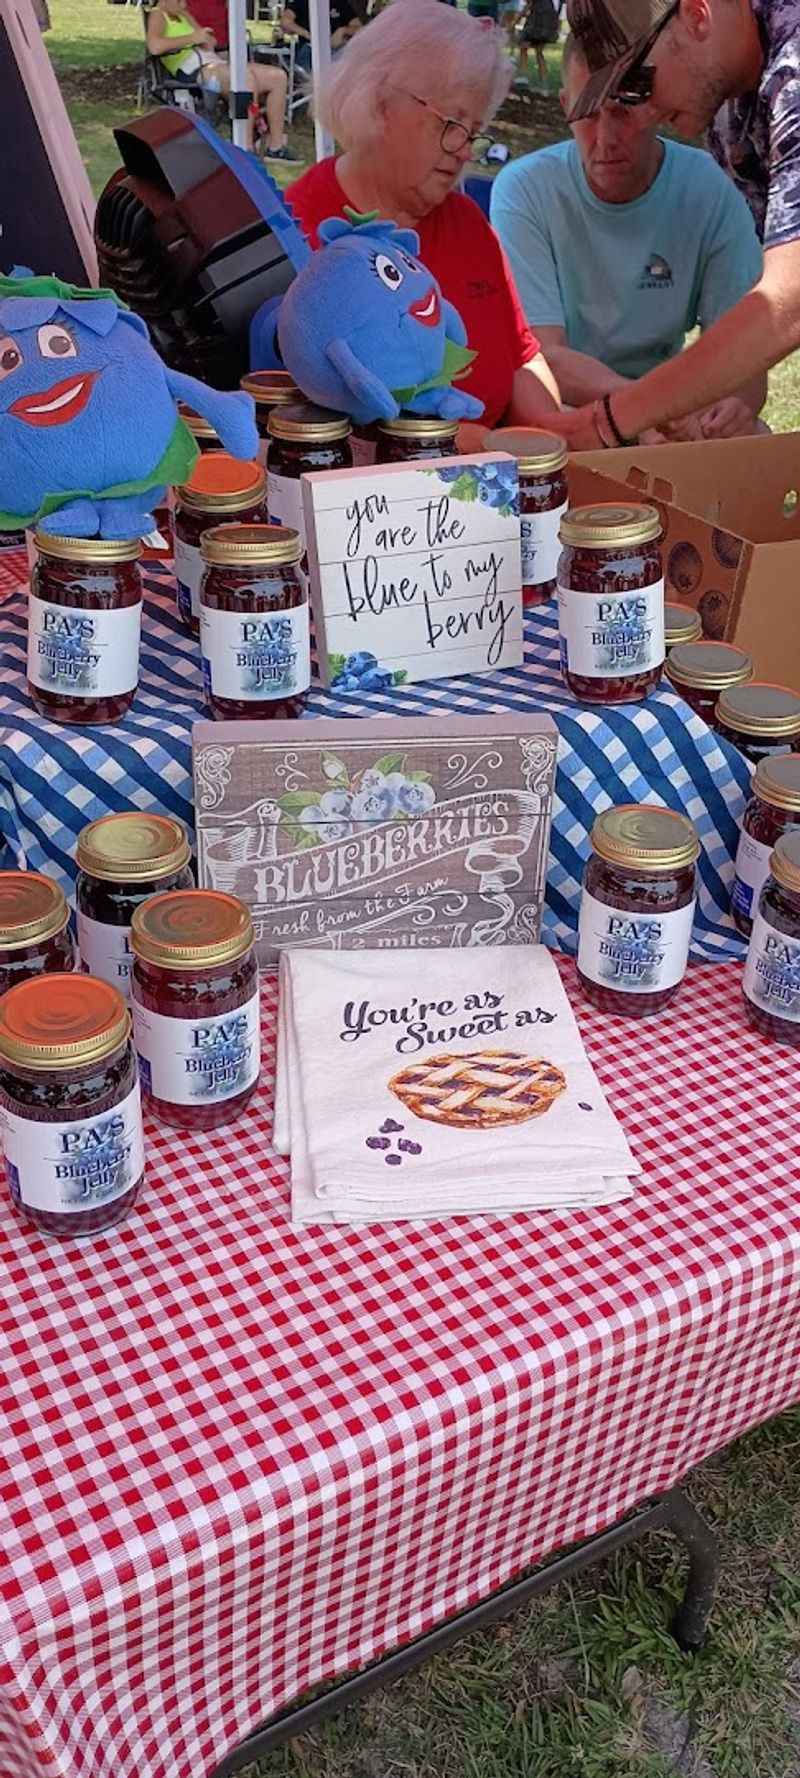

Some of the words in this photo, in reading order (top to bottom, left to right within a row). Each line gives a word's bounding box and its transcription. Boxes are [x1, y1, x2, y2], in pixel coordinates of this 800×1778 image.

[346, 495, 390, 557] you
[375, 526, 417, 550] are
[417, 496, 466, 547] the
[343, 555, 418, 622] blue
[421, 554, 452, 597] to
[464, 553, 504, 607] my
[240, 619, 293, 641] PA'S
[423, 590, 515, 666] berry
[253, 801, 510, 904] BLUEBERRIES
[253, 910, 311, 941] Fresh
[315, 909, 362, 933] from
[364, 890, 394, 915] the
[395, 877, 449, 904] Farm
[377, 934, 442, 949] miles
[340, 997, 456, 1043] You're
[465, 990, 503, 1011] as
[396, 1011, 508, 1054] Sweet
[515, 1006, 557, 1028] as
